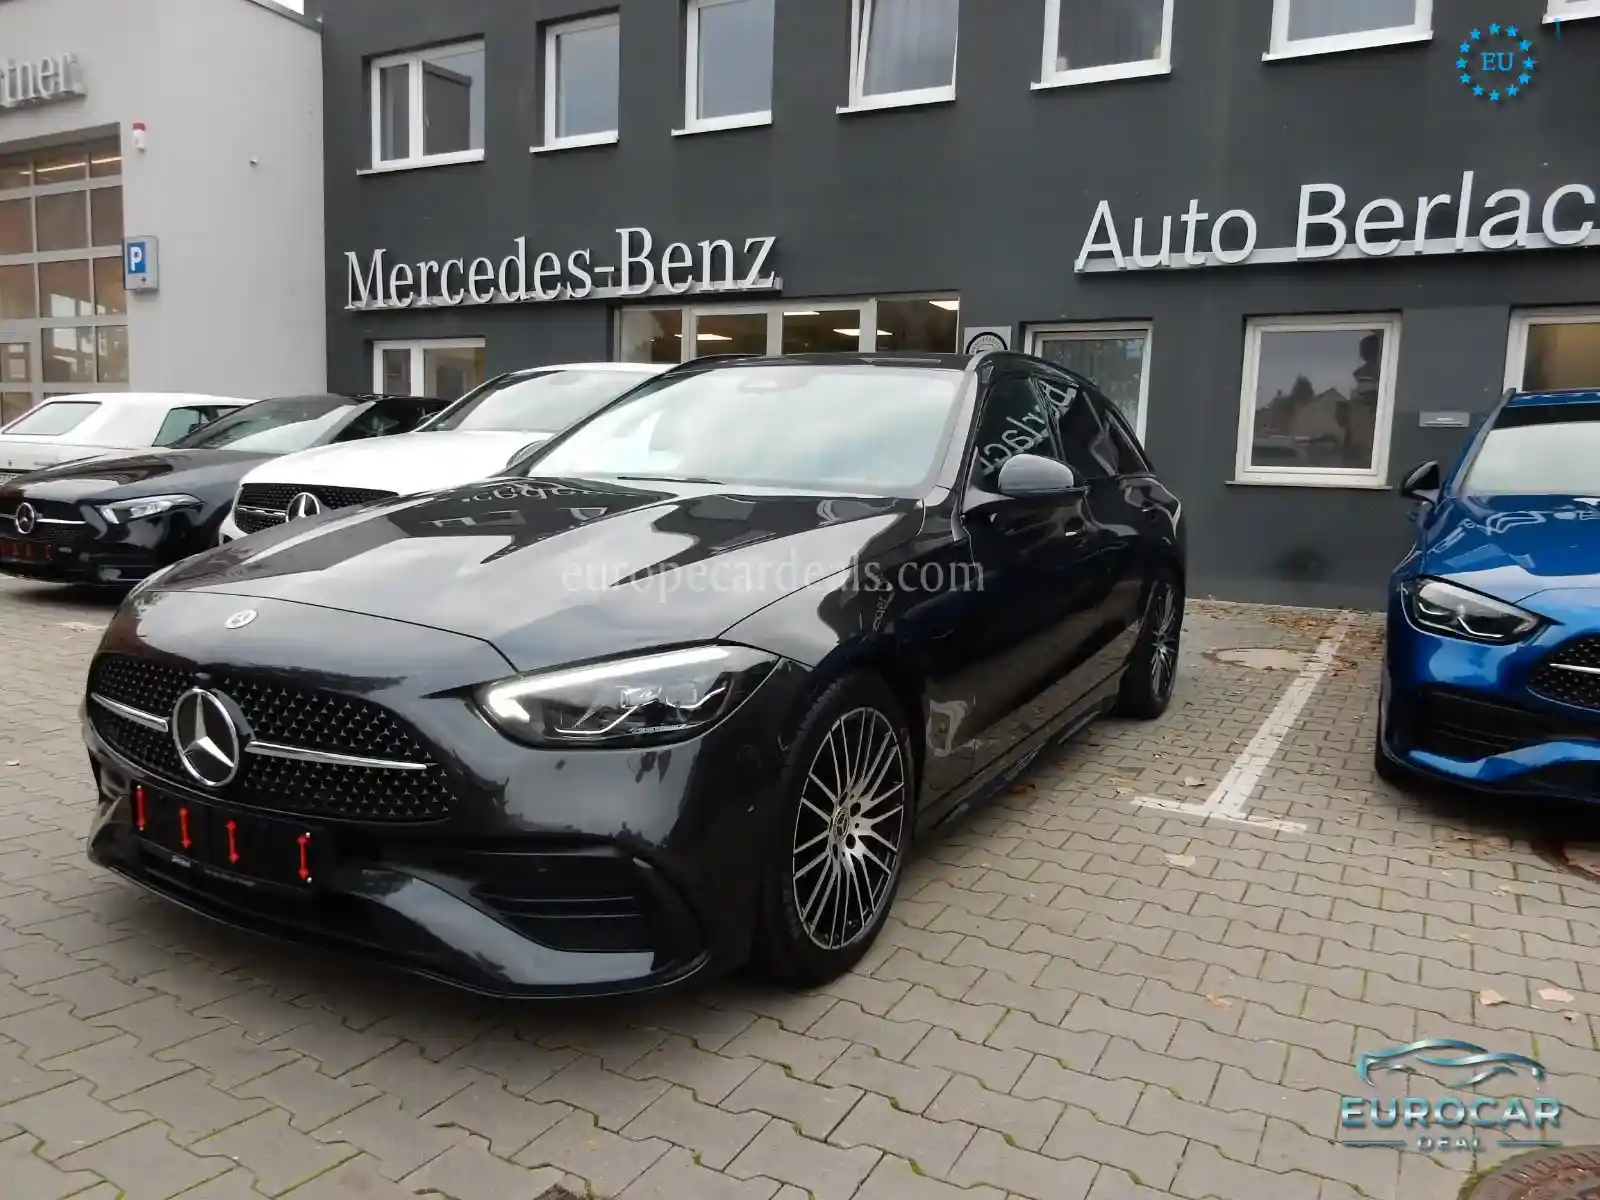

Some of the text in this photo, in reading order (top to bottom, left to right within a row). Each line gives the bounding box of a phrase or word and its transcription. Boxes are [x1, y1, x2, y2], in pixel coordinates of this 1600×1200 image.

[130, 246, 143, 271] P
[1074, 171, 1595, 271] Auto Berlac
[344, 227, 777, 310] Mercedes-Benz
